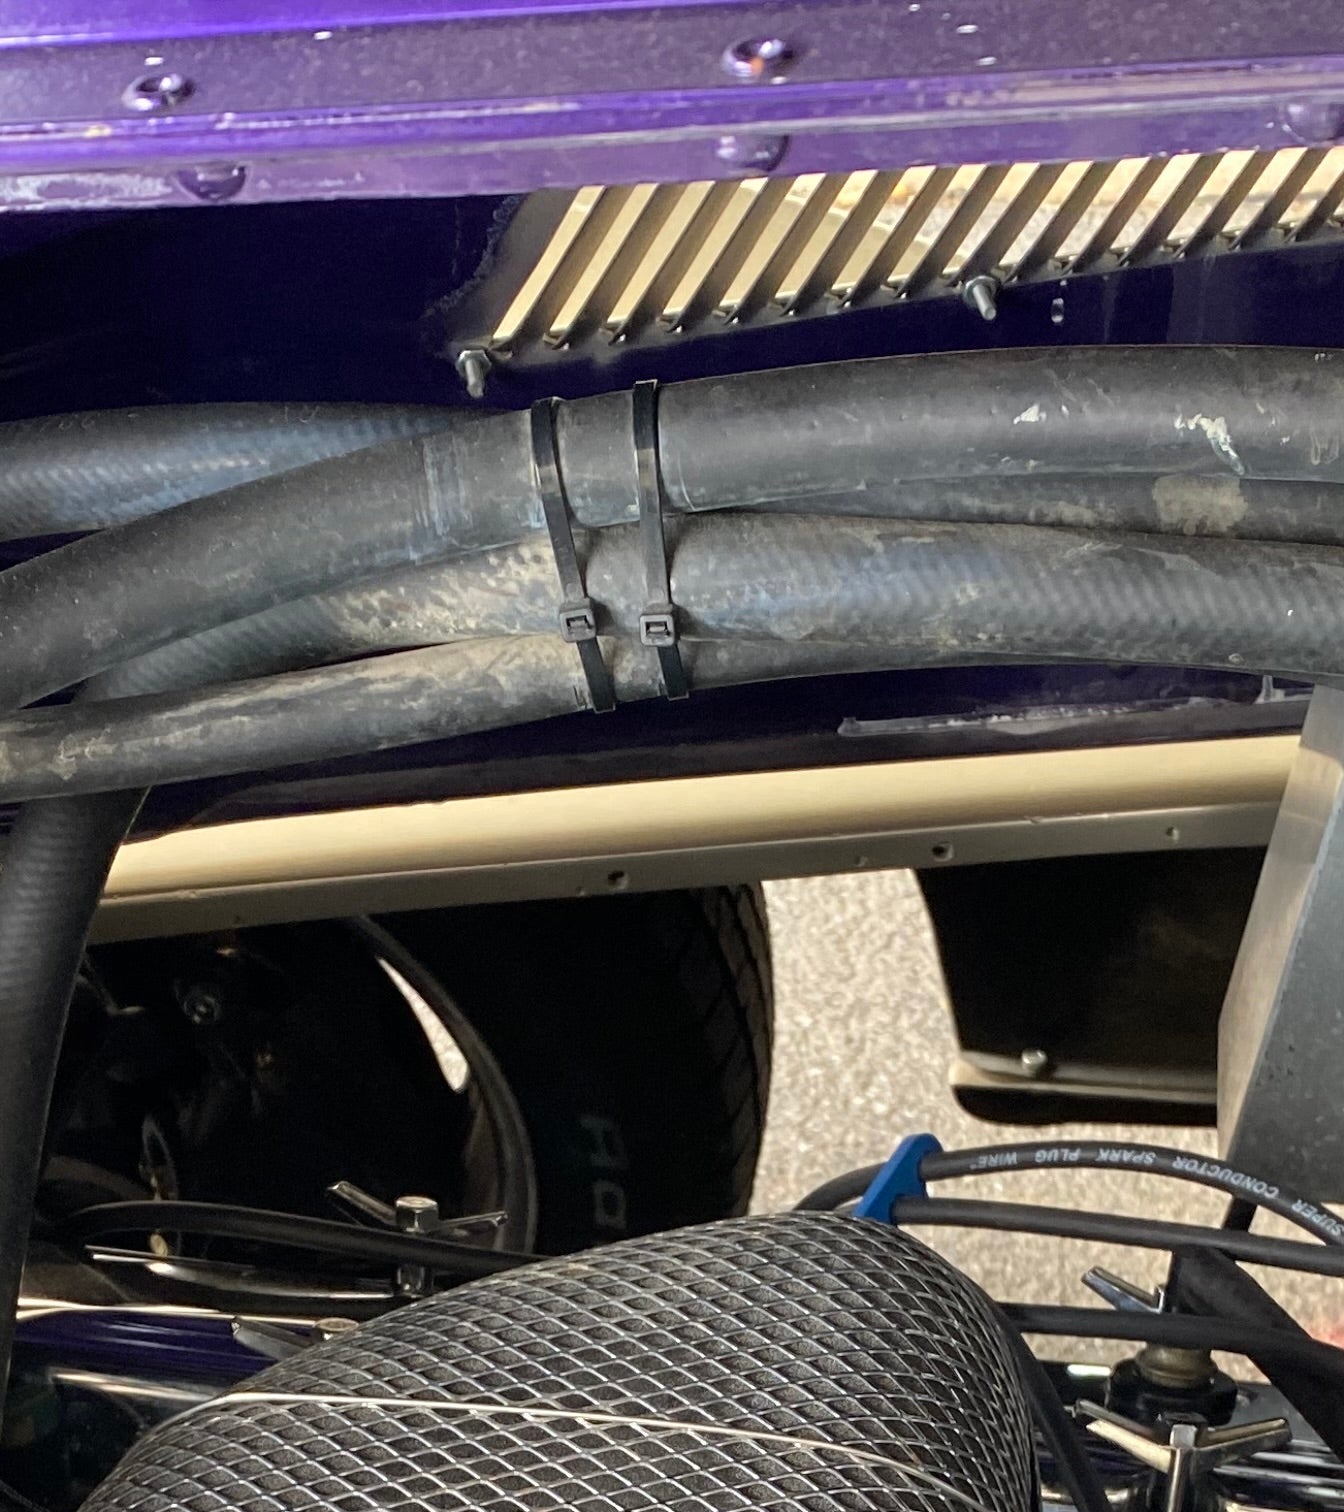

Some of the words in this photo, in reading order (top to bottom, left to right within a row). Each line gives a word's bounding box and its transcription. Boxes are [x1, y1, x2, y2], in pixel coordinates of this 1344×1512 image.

[1034, 1147, 1081, 1163] PLUG
[1096, 1148, 1156, 1165] SPARK
[1171, 1154, 1280, 1199] CONDUCTOR
